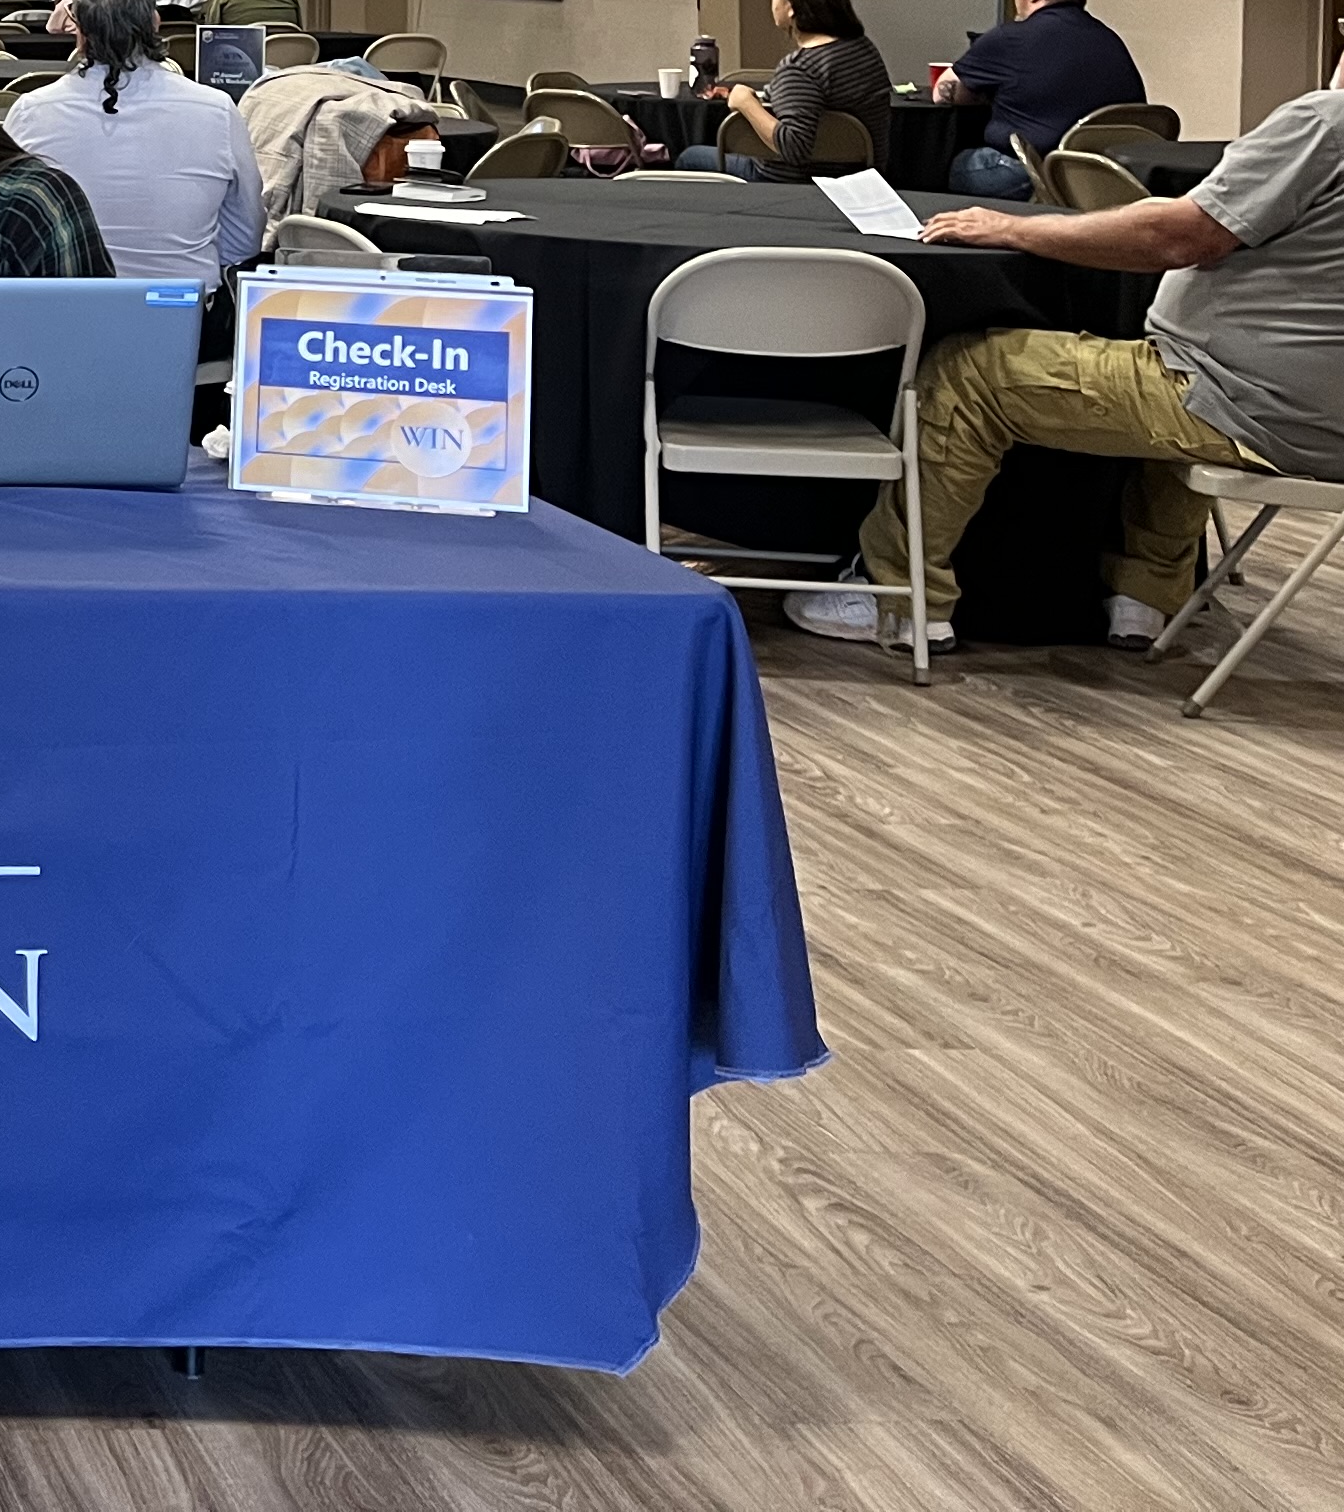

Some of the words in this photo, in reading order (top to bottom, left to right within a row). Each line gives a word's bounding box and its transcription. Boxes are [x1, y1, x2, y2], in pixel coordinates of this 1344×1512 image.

[297, 330, 469, 371] Check-In
[3, 379, 35, 389] DELL
[309, 370, 410, 392] Registration
[414, 377, 457, 395] Desk
[400, 425, 465, 452] WIN
